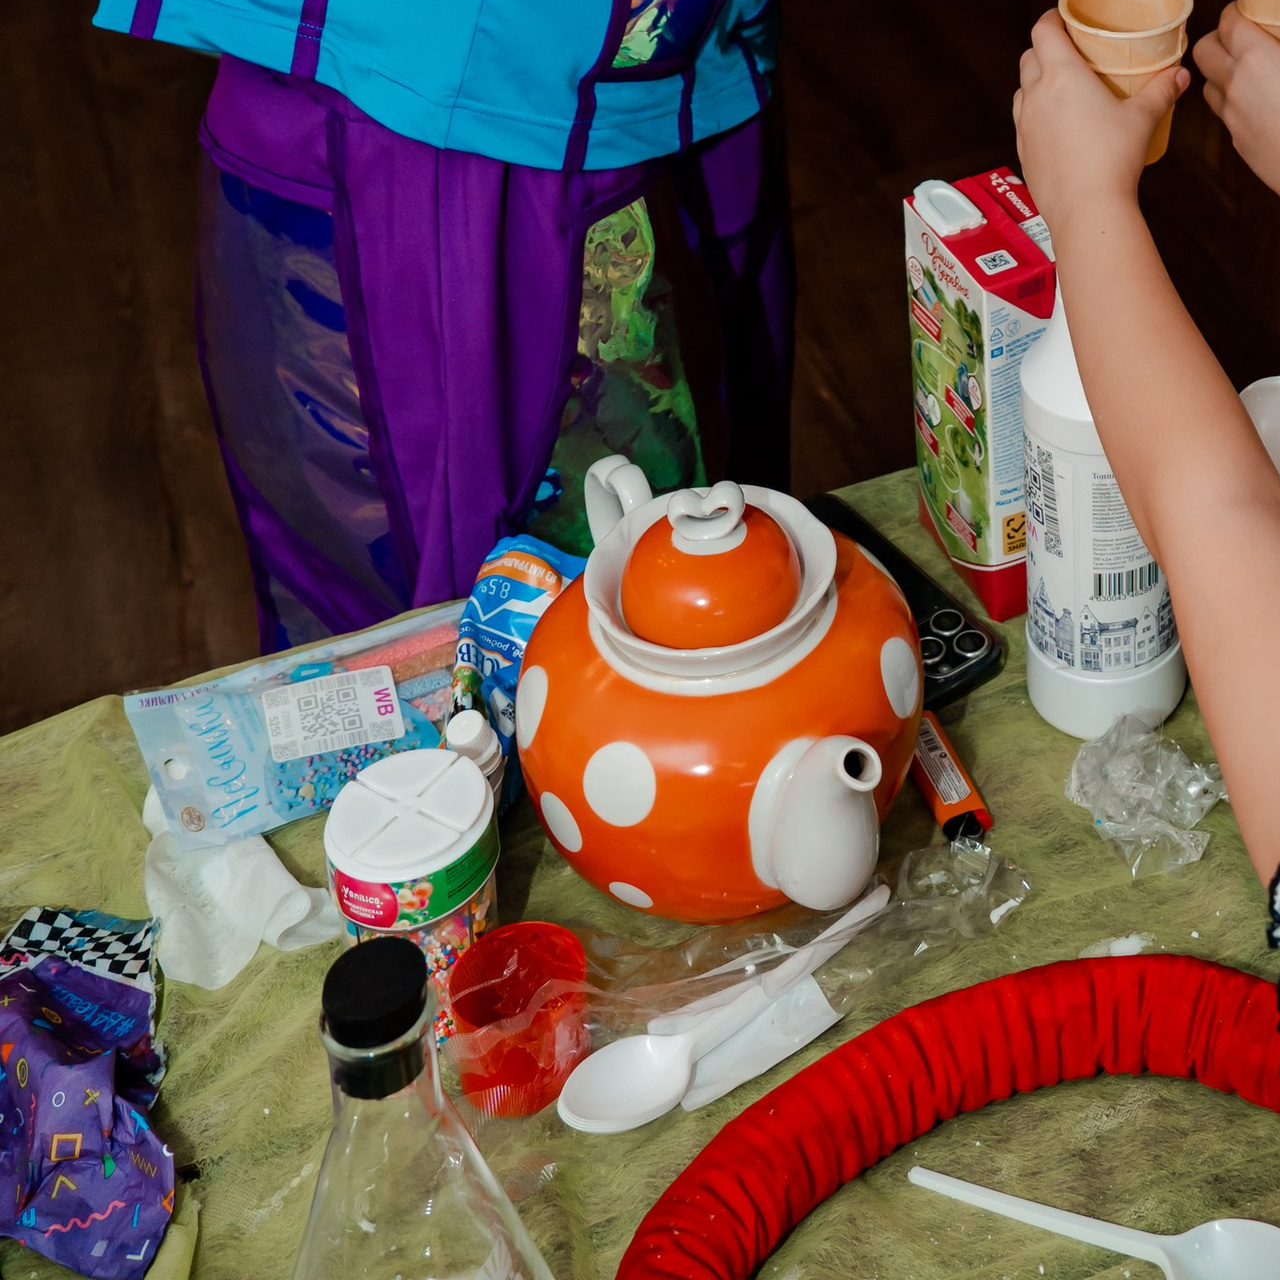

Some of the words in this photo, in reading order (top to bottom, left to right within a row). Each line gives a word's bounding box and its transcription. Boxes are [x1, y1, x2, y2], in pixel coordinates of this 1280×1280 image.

[477, 577, 511, 599] 8,5%
[374, 687, 395, 717] WB
[269, 716, 282, 738] 5255
